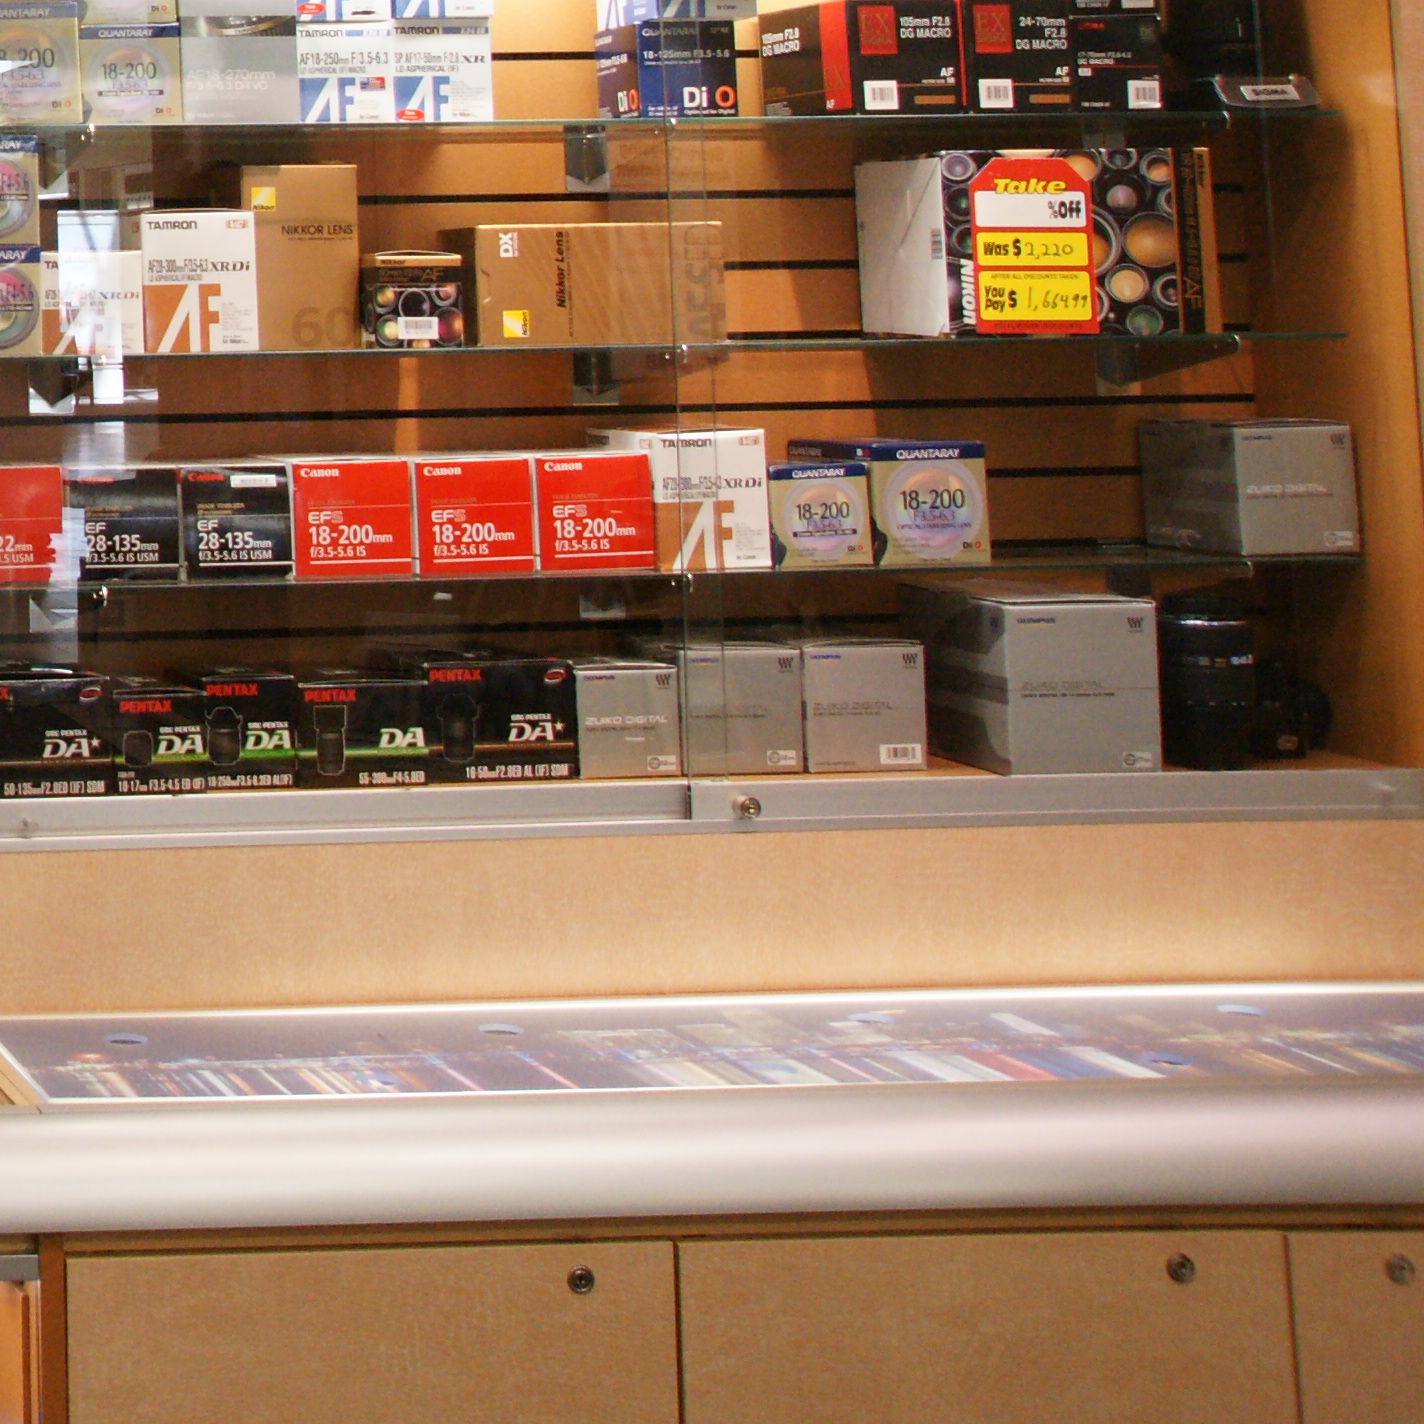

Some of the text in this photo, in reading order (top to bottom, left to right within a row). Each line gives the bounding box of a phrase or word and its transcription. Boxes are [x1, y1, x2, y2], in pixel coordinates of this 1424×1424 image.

[103, 62, 157, 80] 18-200
[994, 178, 1066, 194] Take
[147, 220, 197, 230] TAMRON
[281, 225, 353, 234] NIKKOR LENS
[500, 232, 514, 258] DX
[983, 241, 1009, 256] Was
[896, 448, 960, 459] QUANTARAY
[300, 467, 339, 477] Canon
[423, 465, 462, 476] Canon
[544, 461, 582, 472] Canon
[900, 489, 964, 510] 18-200
[206, 684, 257, 696] PENTAX
[119, 701, 172, 713] PENTAX
[380, 728, 424, 748] DA
